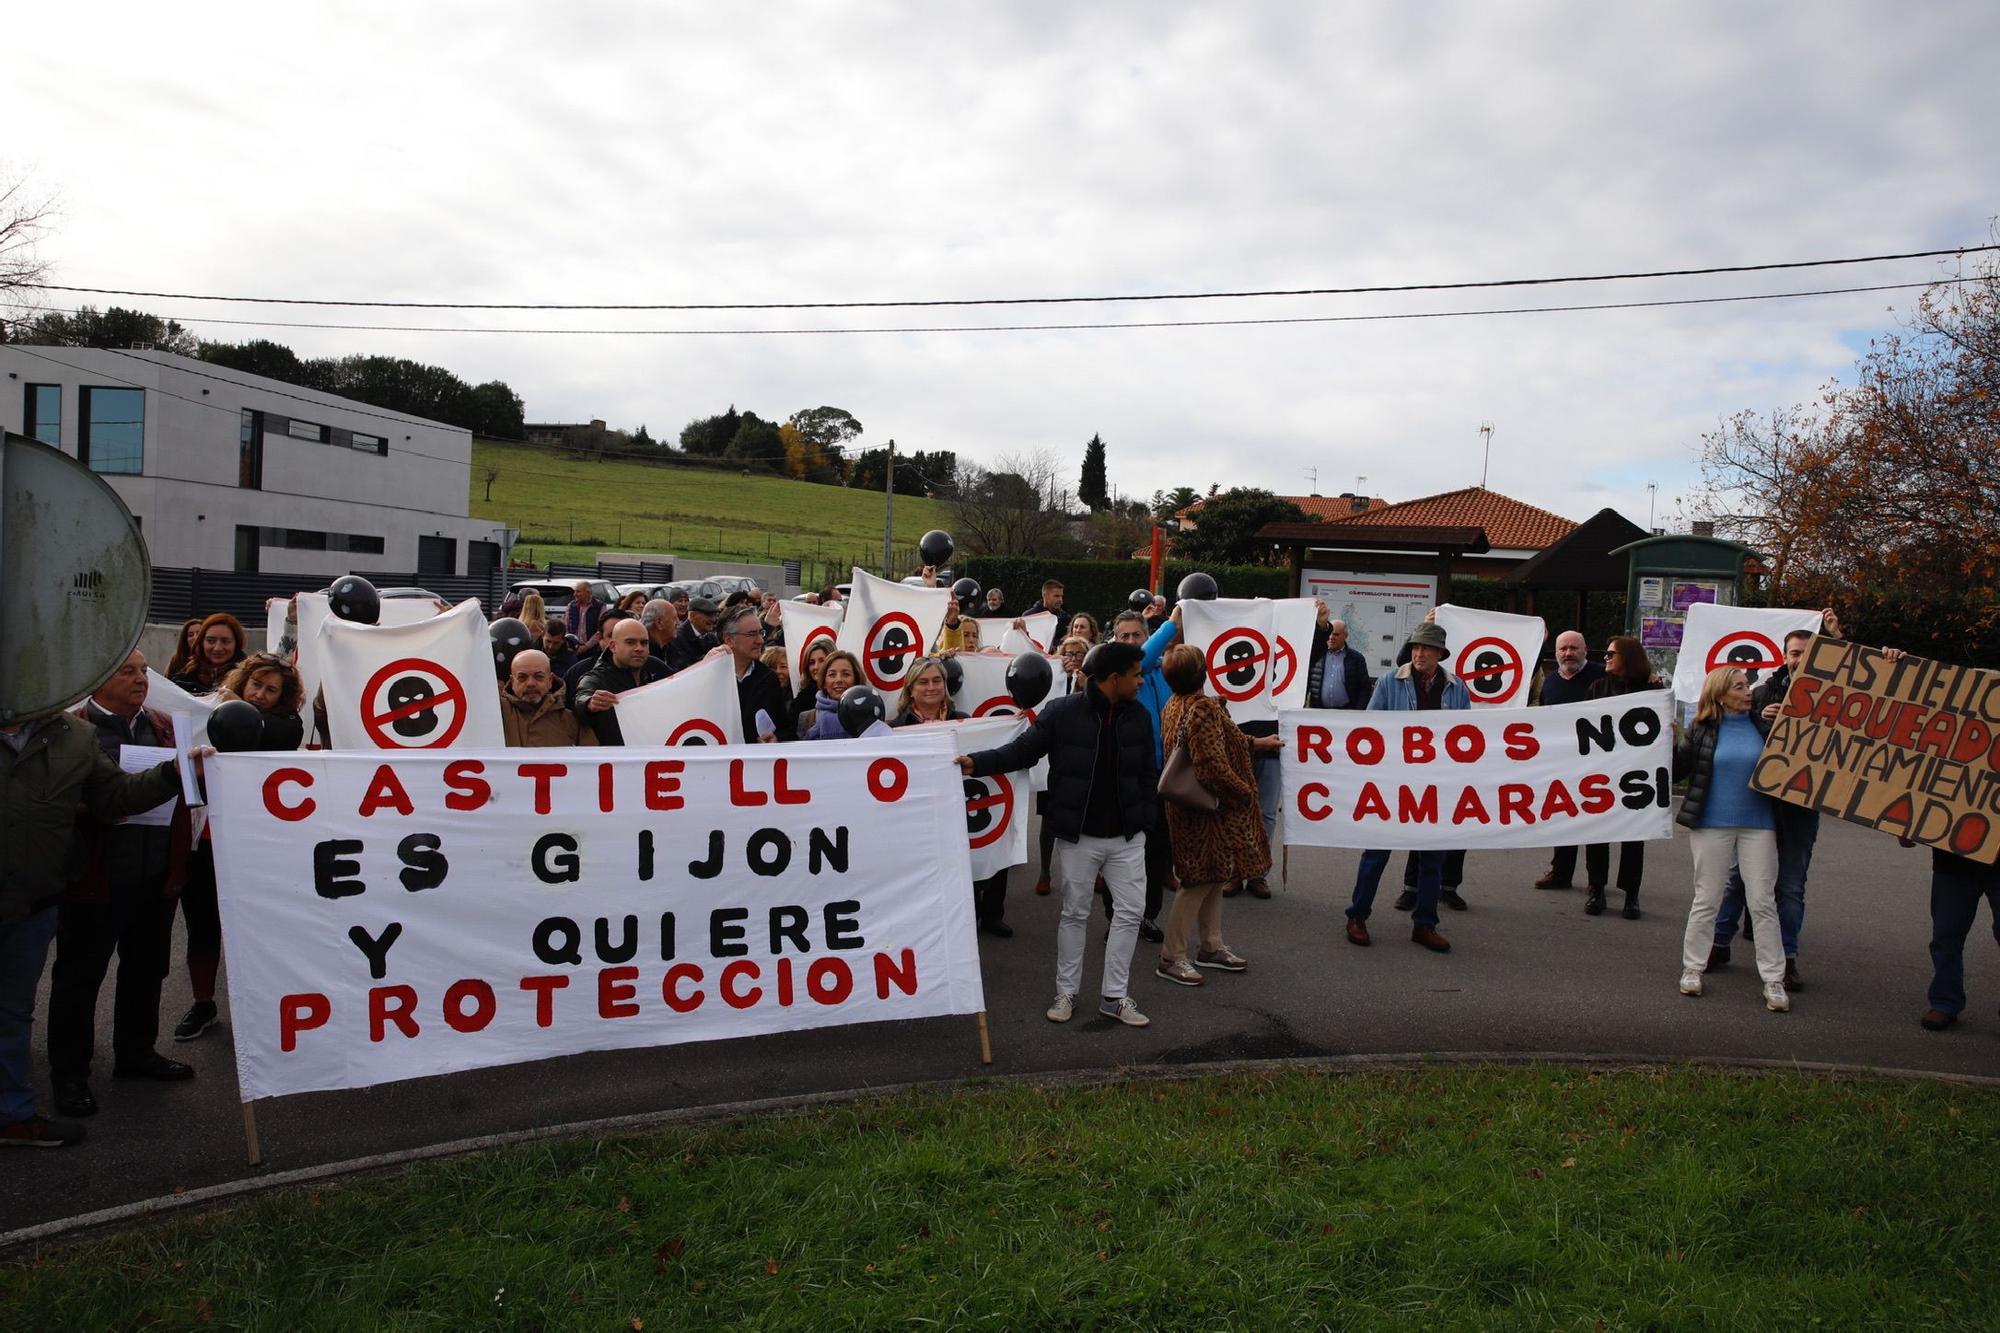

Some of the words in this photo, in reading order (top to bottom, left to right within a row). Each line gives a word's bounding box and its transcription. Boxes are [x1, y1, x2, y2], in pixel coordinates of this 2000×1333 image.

[1804, 636, 2000, 724] CASTIELLO
[1297, 723, 1541, 765] ROBOS
[1576, 706, 1661, 756] NO
[1752, 754, 1991, 855] CALLADO
[313, 833, 449, 899] ES
[531, 826, 849, 884] GIJON
[349, 922, 402, 979] Y
[532, 899, 865, 966] QUIERE
[280, 948, 918, 1051] PROTECCION
